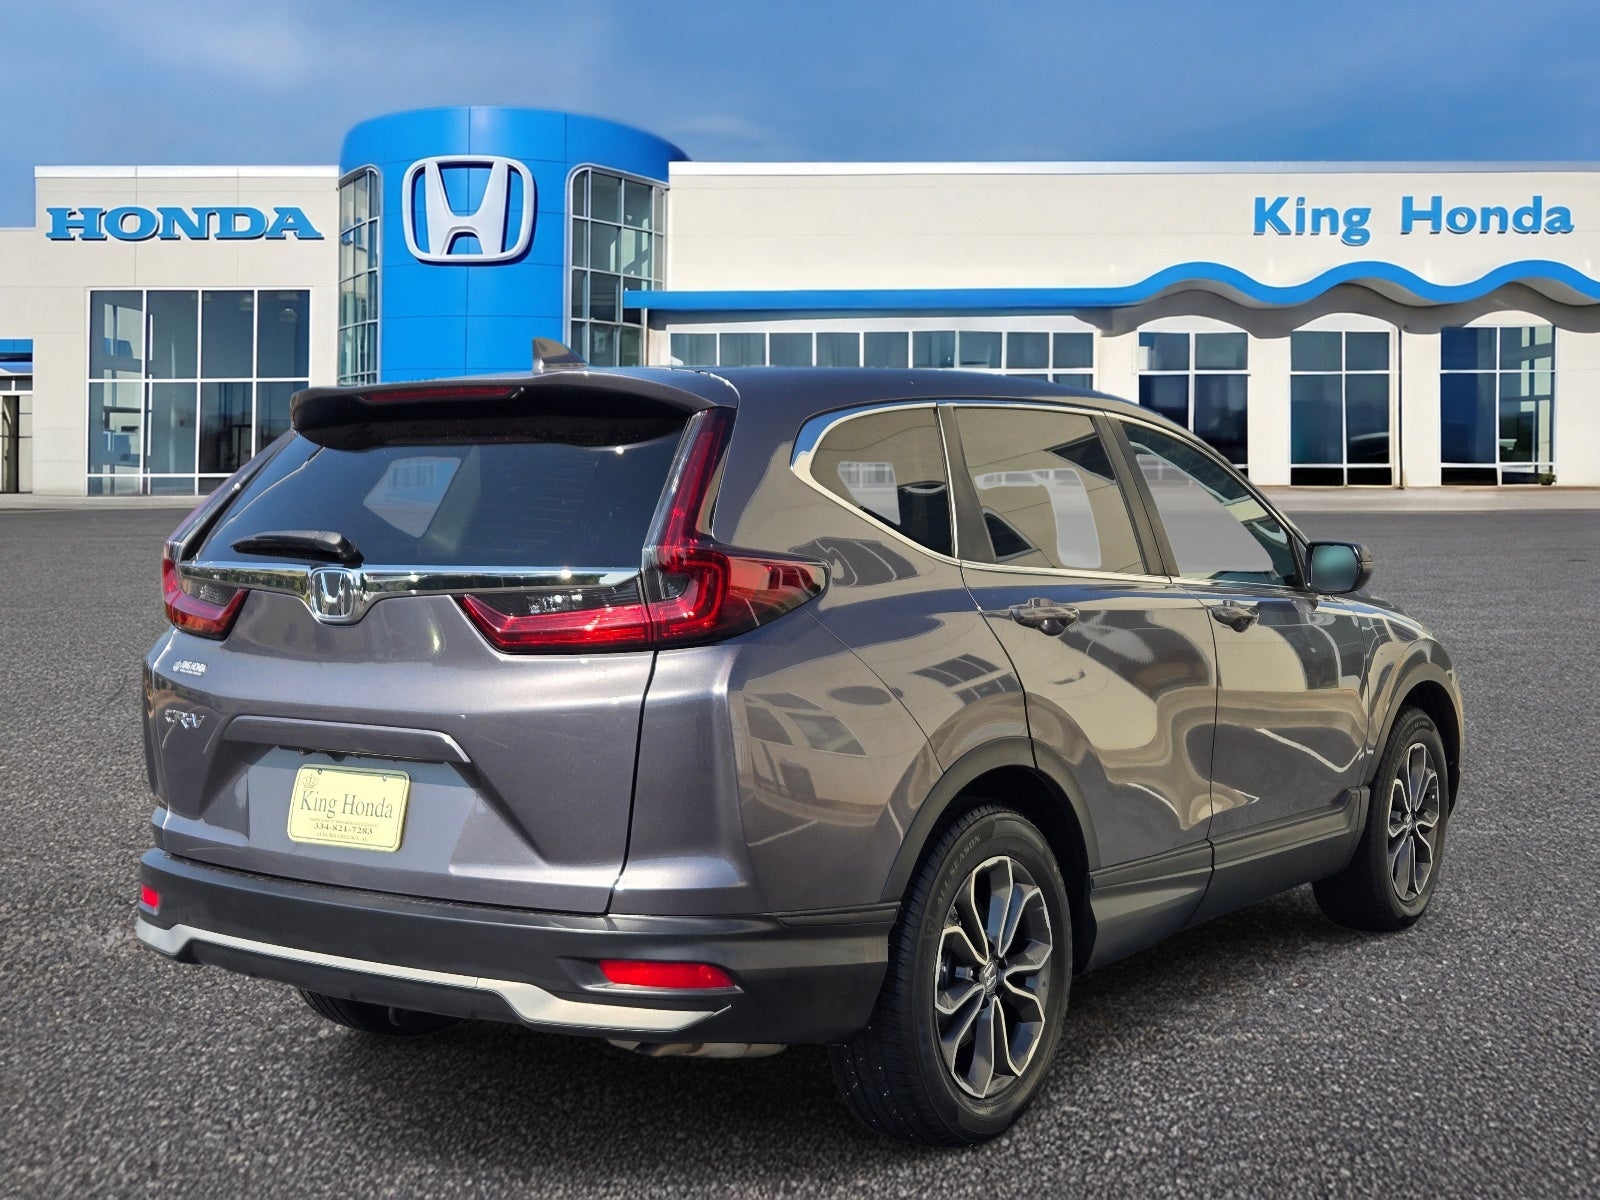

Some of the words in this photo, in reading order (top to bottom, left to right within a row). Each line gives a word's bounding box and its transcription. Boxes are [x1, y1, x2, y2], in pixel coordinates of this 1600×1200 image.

[45, 206, 324, 241] HONDA
[1253, 196, 1372, 247] King
[1400, 195, 1575, 235] Honda
[300, 789, 337, 818] King
[341, 793, 393, 818] Honda
[313, 822, 373, 835] 334-821-7283
